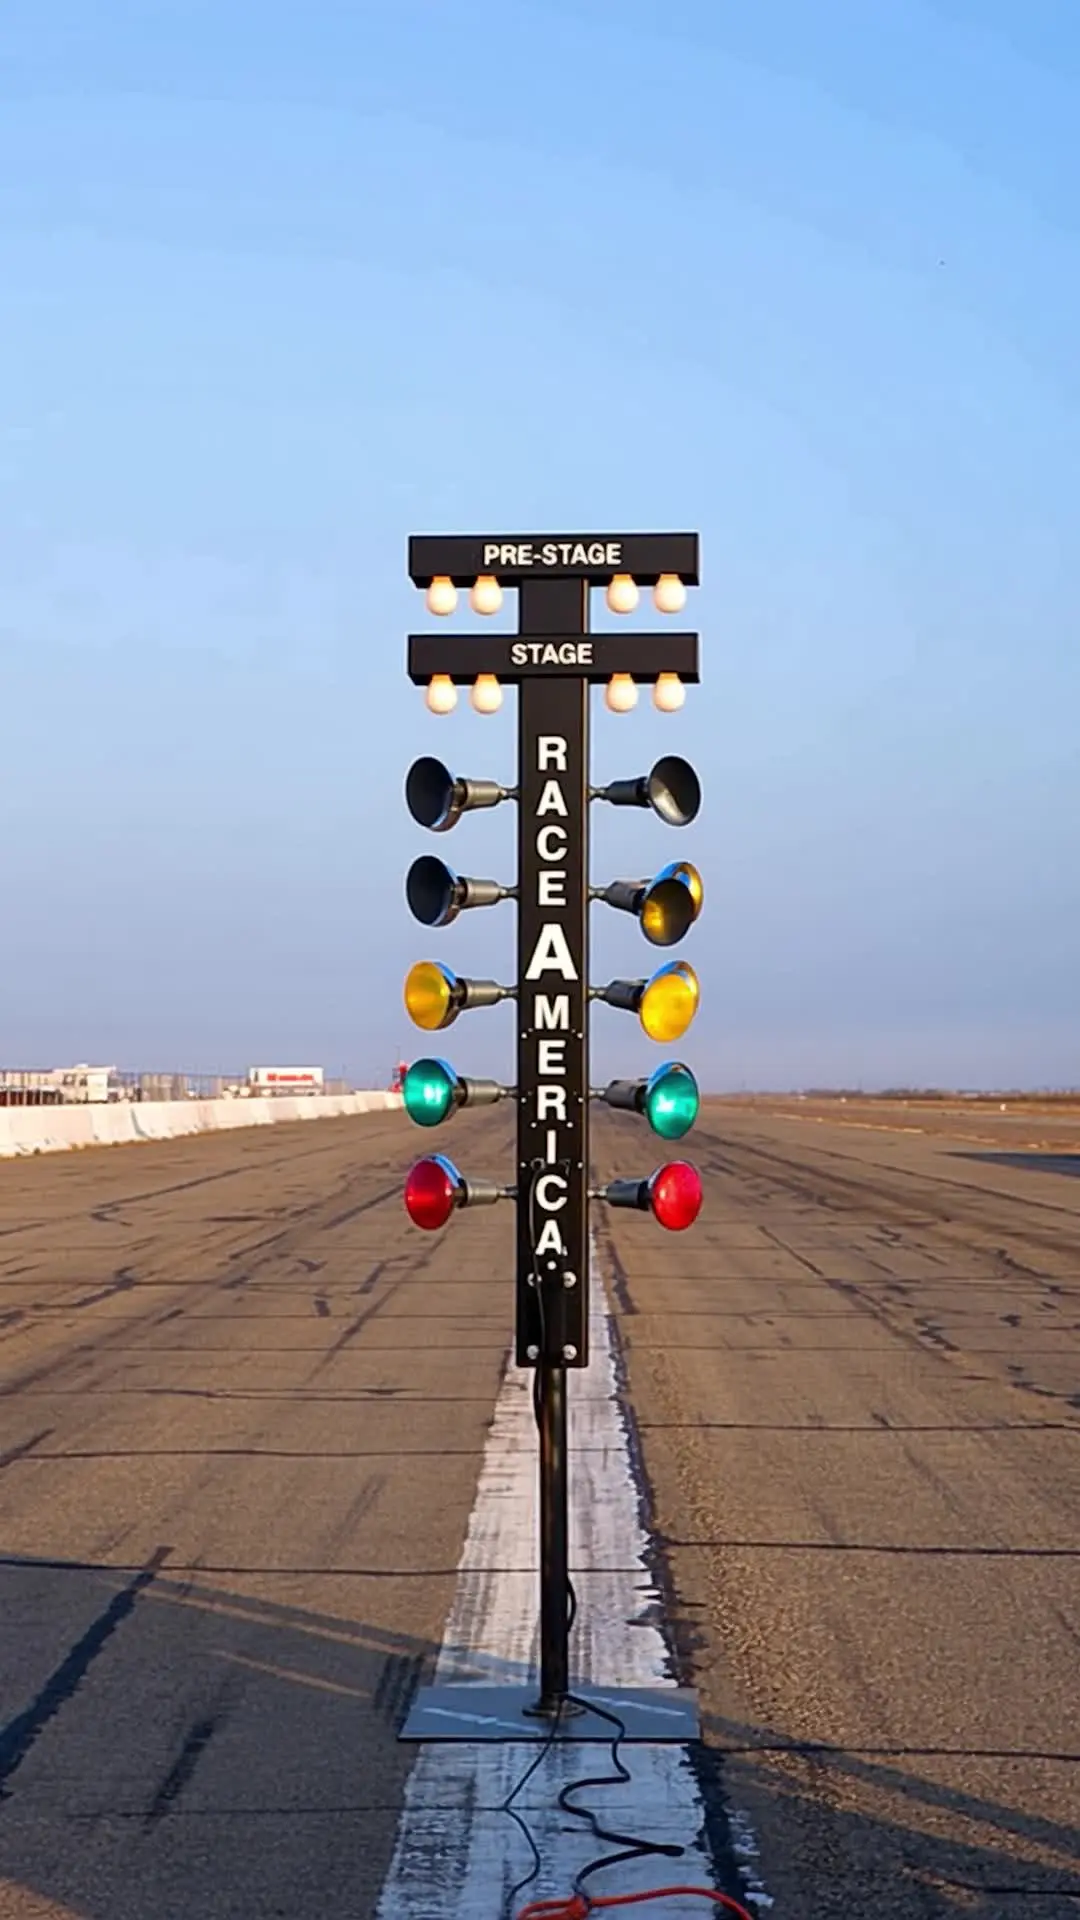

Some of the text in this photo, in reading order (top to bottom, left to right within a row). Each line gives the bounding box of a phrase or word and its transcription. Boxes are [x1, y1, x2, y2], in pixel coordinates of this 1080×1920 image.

[483, 543, 622, 566] PRE-STAGE
[511, 643, 593, 665] STAGE
[525, 736, 578, 1256] RACE AMERICA
